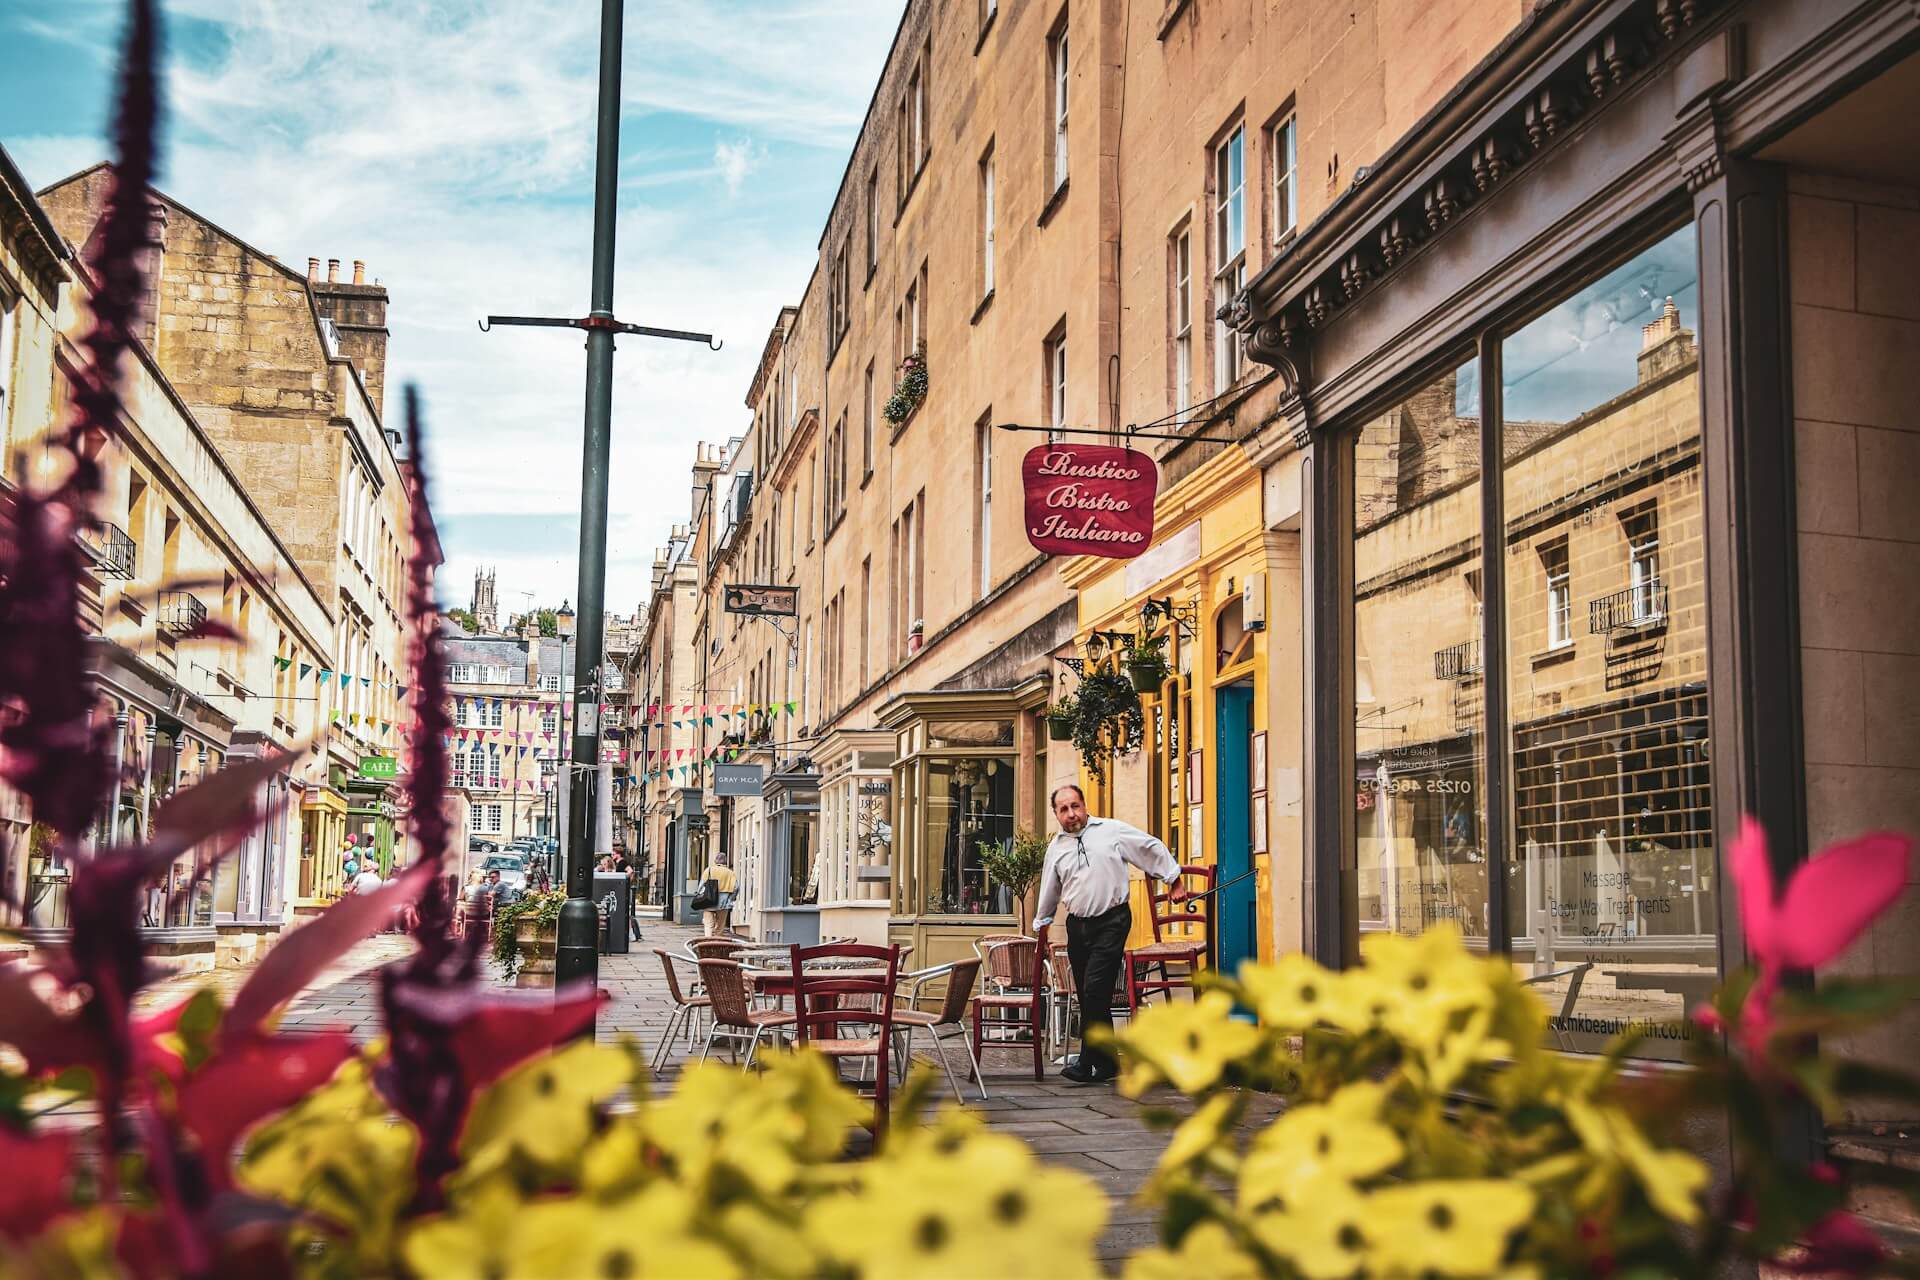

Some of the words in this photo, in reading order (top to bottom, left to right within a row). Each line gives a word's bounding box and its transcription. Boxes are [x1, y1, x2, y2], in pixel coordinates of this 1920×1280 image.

[1038, 451, 1141, 481] Rustico
[1563, 415, 1687, 502] BEAUTY
[1046, 482, 1132, 512] Bistro
[1032, 514, 1144, 544] Italiano
[749, 595, 792, 605] UBER
[719, 776, 737, 784] GRAY
[1583, 871, 1631, 889] Massage
[1551, 898, 1577, 920] Body
[1606, 897, 1671, 915] Treatments
[1616, 925, 1636, 943] Tan
[1547, 1012, 1698, 1040] ww.mkbeautybath.co.u
